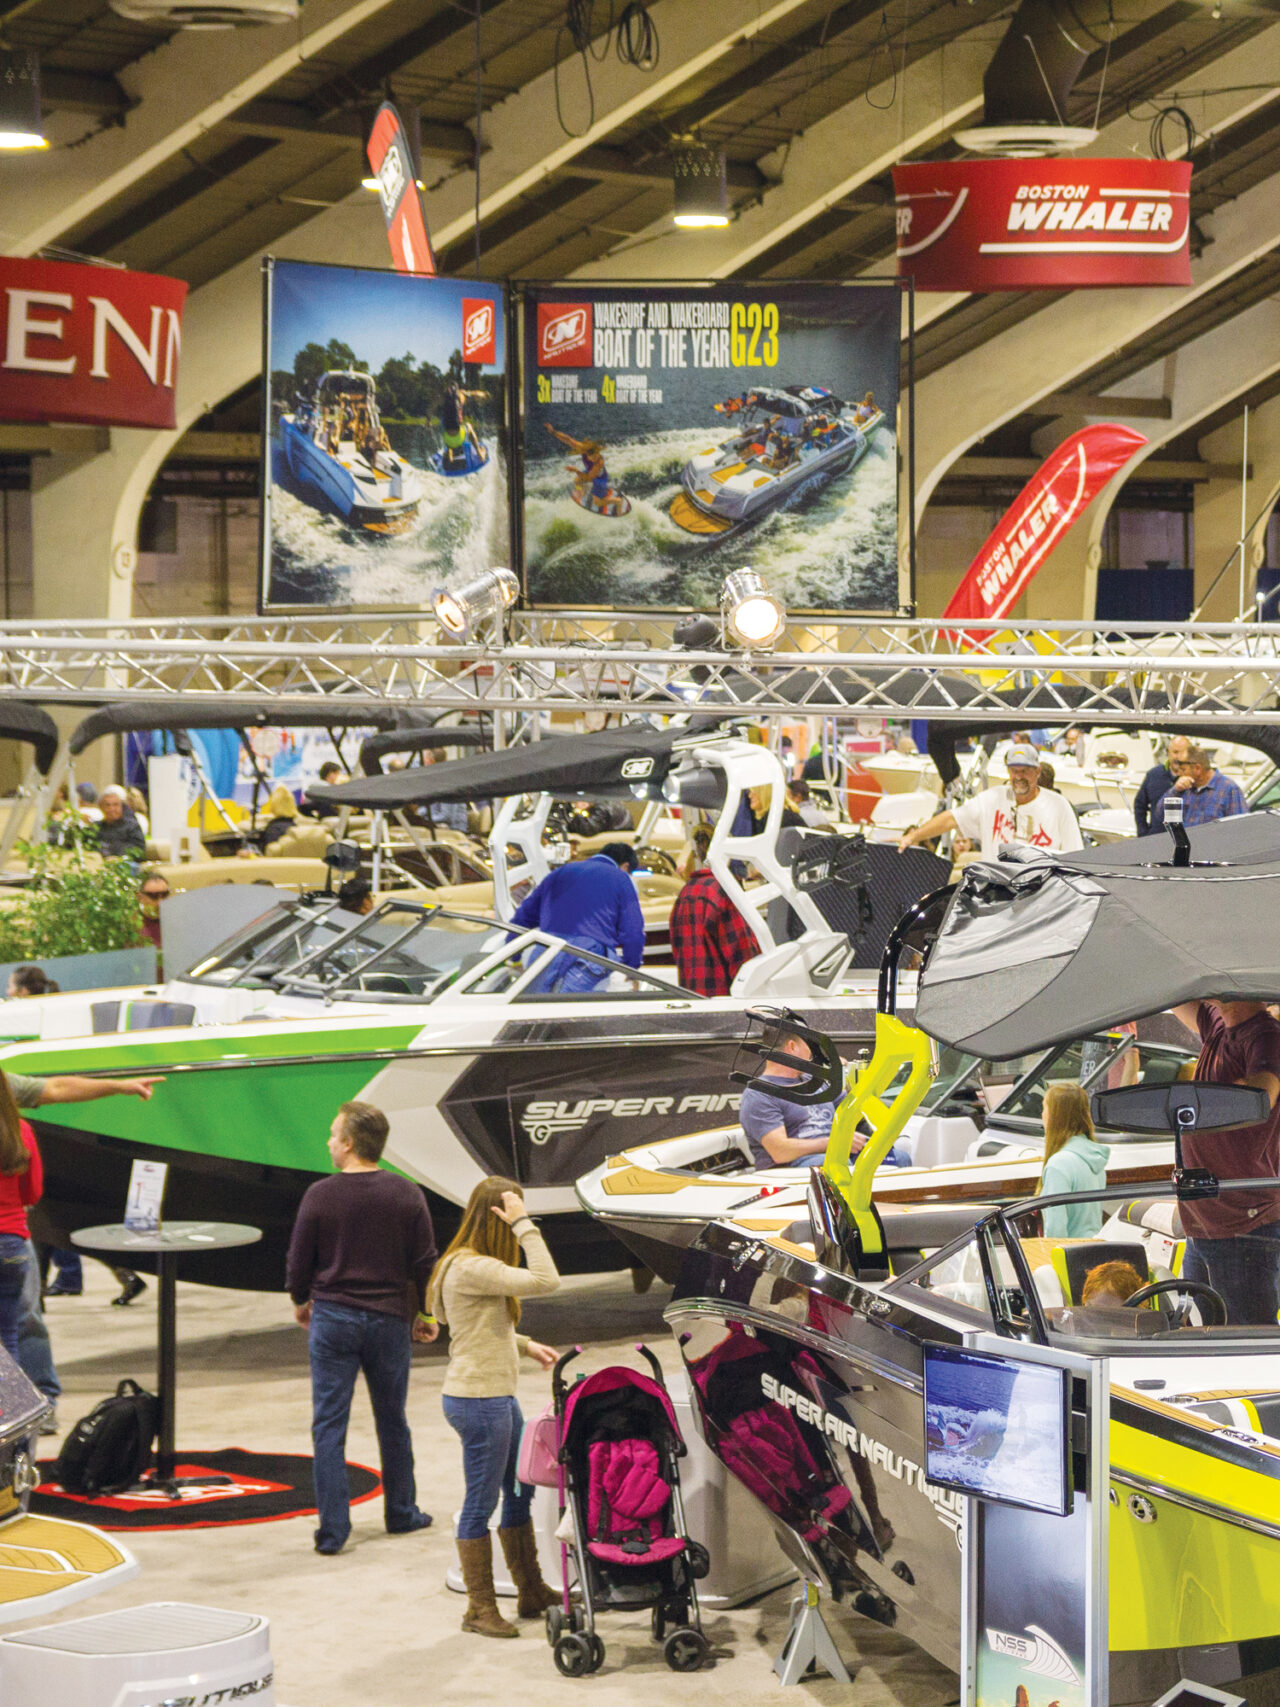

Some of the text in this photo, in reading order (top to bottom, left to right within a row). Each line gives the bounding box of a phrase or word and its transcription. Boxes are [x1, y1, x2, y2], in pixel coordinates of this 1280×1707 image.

[1015, 185, 1089, 200] BOSTON
[1007, 202, 1173, 231] WHALER
[594, 302, 730, 329] WAKESURF AND WAKEBOARD
[594, 329, 730, 369] BOAT OF THE YEAR
[731, 302, 779, 368] G23
[981, 493, 1060, 605] WHALER
[523, 1093, 742, 1120] SUPER AIR
[761, 1372, 823, 1432] SUPER
[825, 1411, 858, 1454] AIR
[995, 1633, 1027, 1653] NSS
